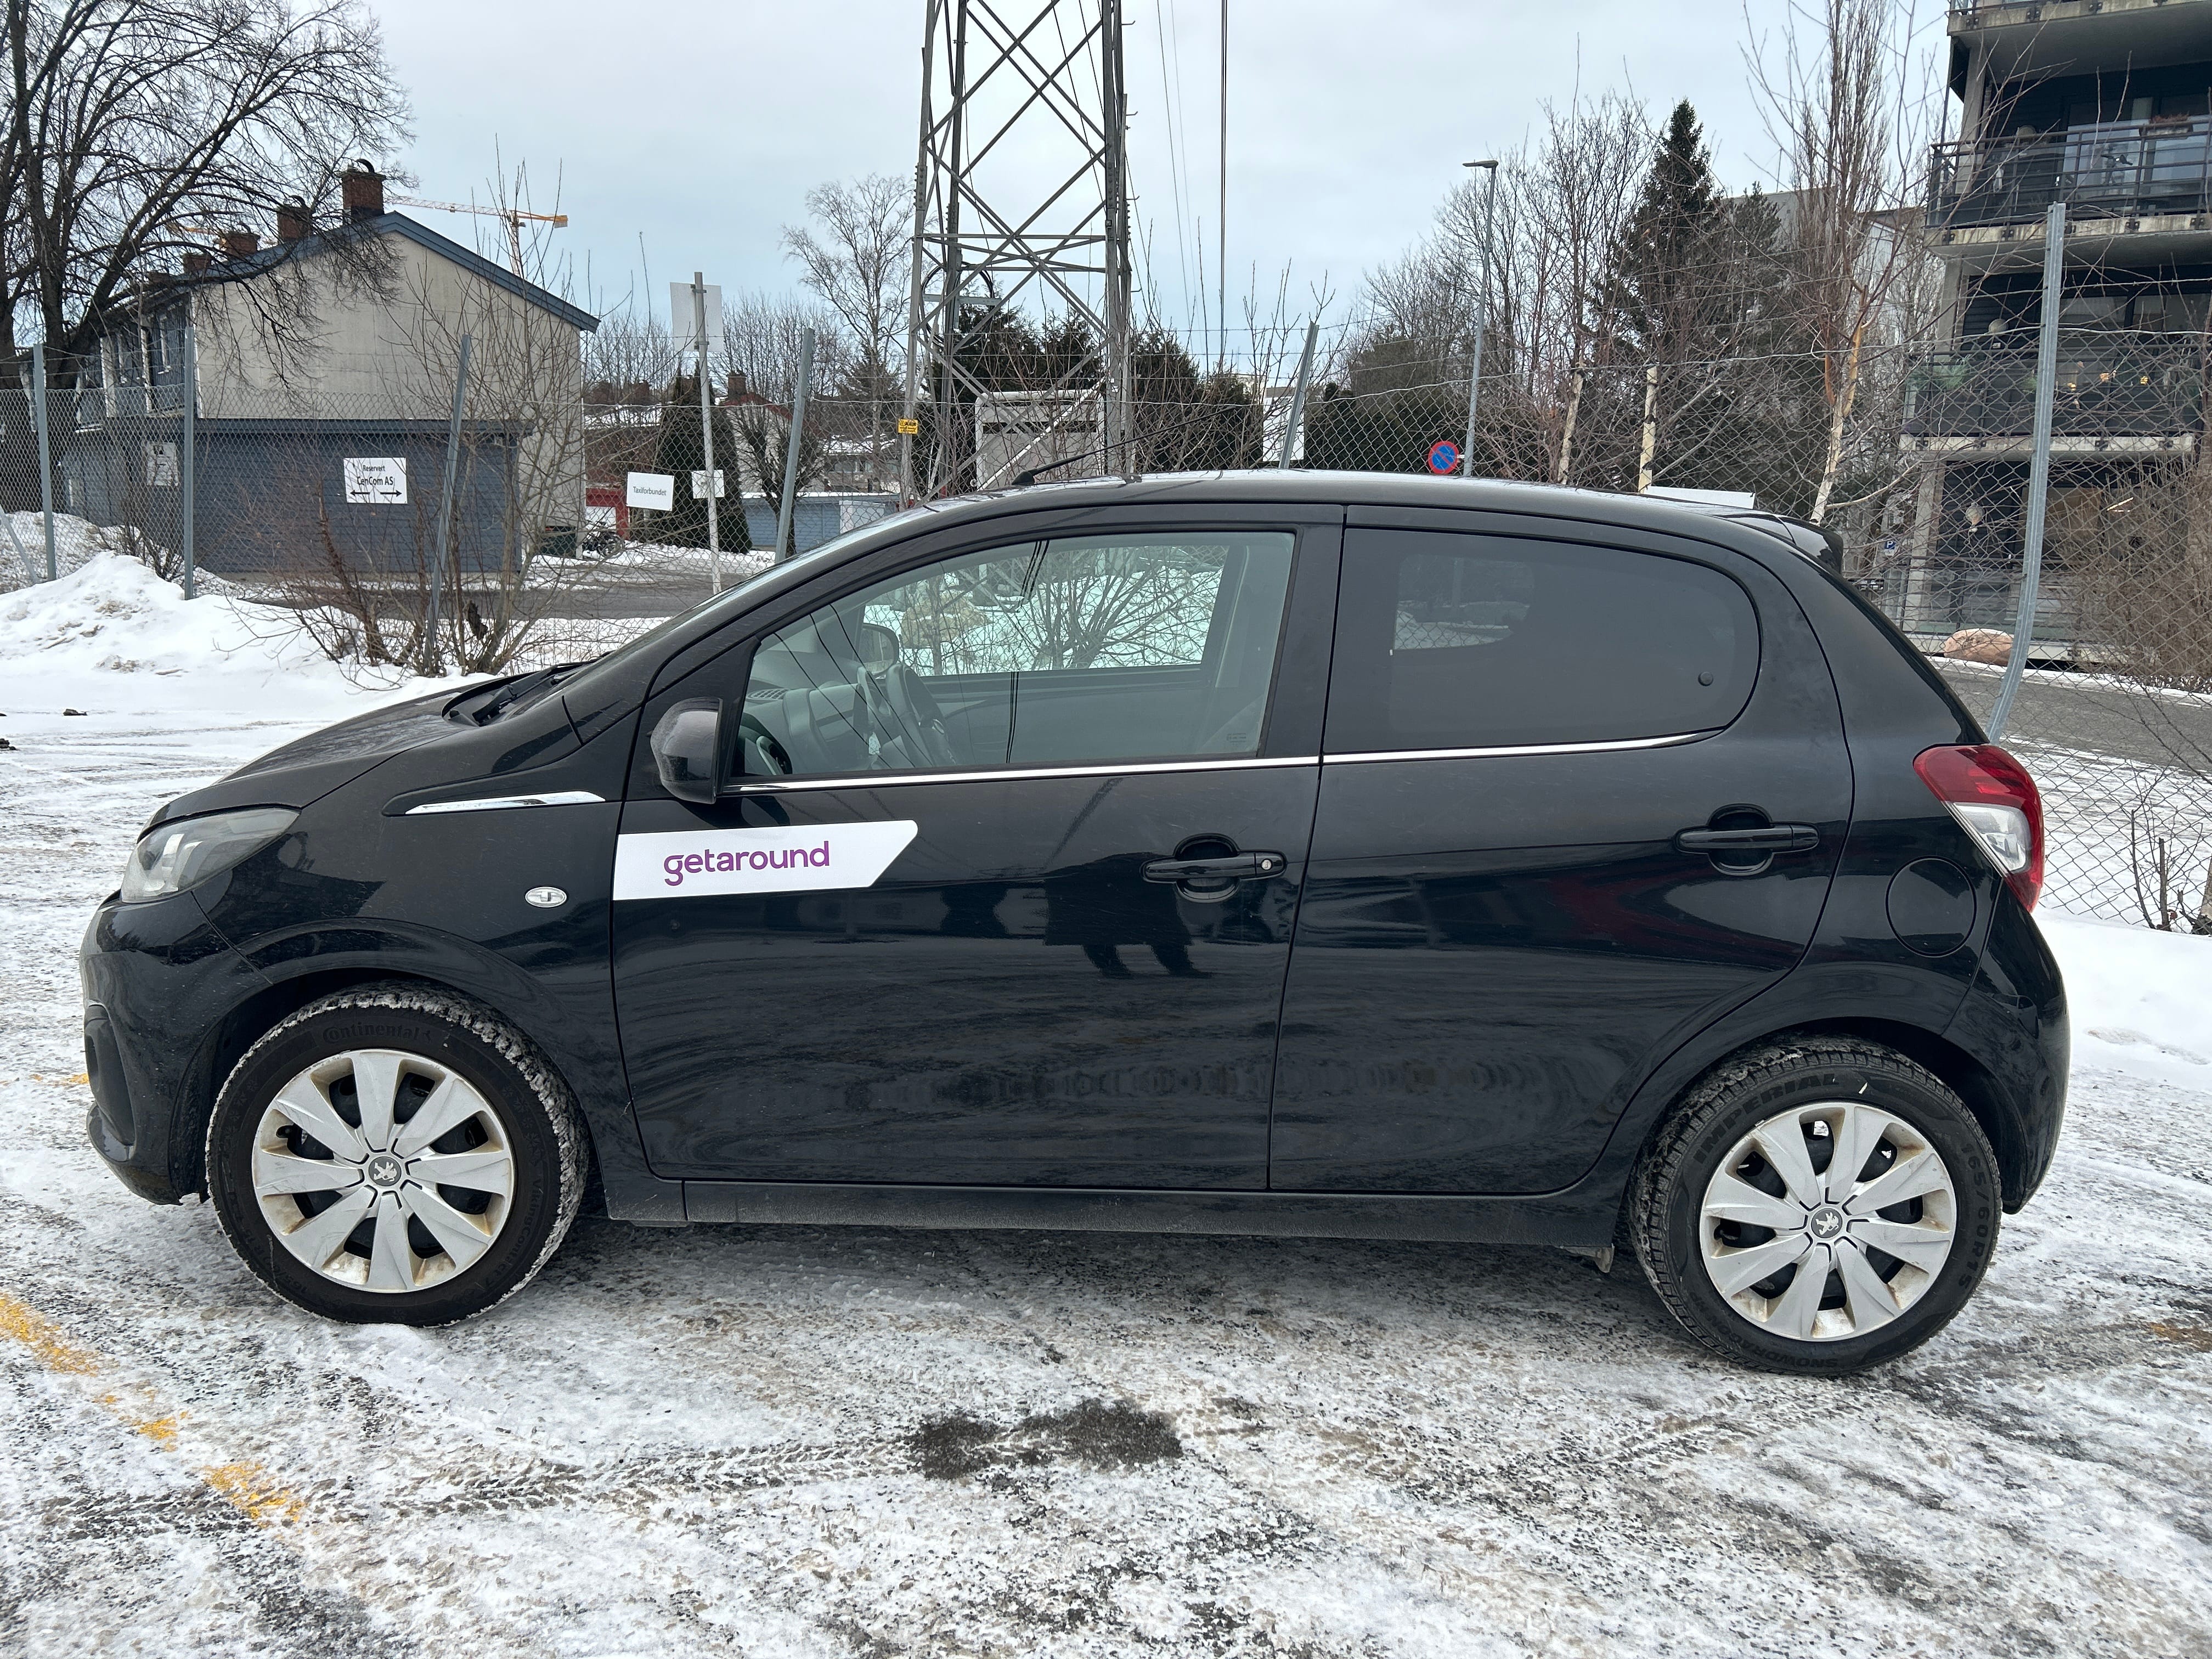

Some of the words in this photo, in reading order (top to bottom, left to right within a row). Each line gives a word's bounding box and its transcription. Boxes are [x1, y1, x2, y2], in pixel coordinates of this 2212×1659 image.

[357, 476, 383, 486] CenCom
[385, 476, 393, 486] AS
[633, 486, 667, 496] Taxiforbundet
[664, 840, 830, 887] getaround
[323, 1022, 420, 1043] Continental
[1693, 1073, 1839, 1164] IMPERIAL
[1958, 1143, 1990, 1289] 165/60R15
[1707, 1316, 1839, 1367] SNOWDRAGON
